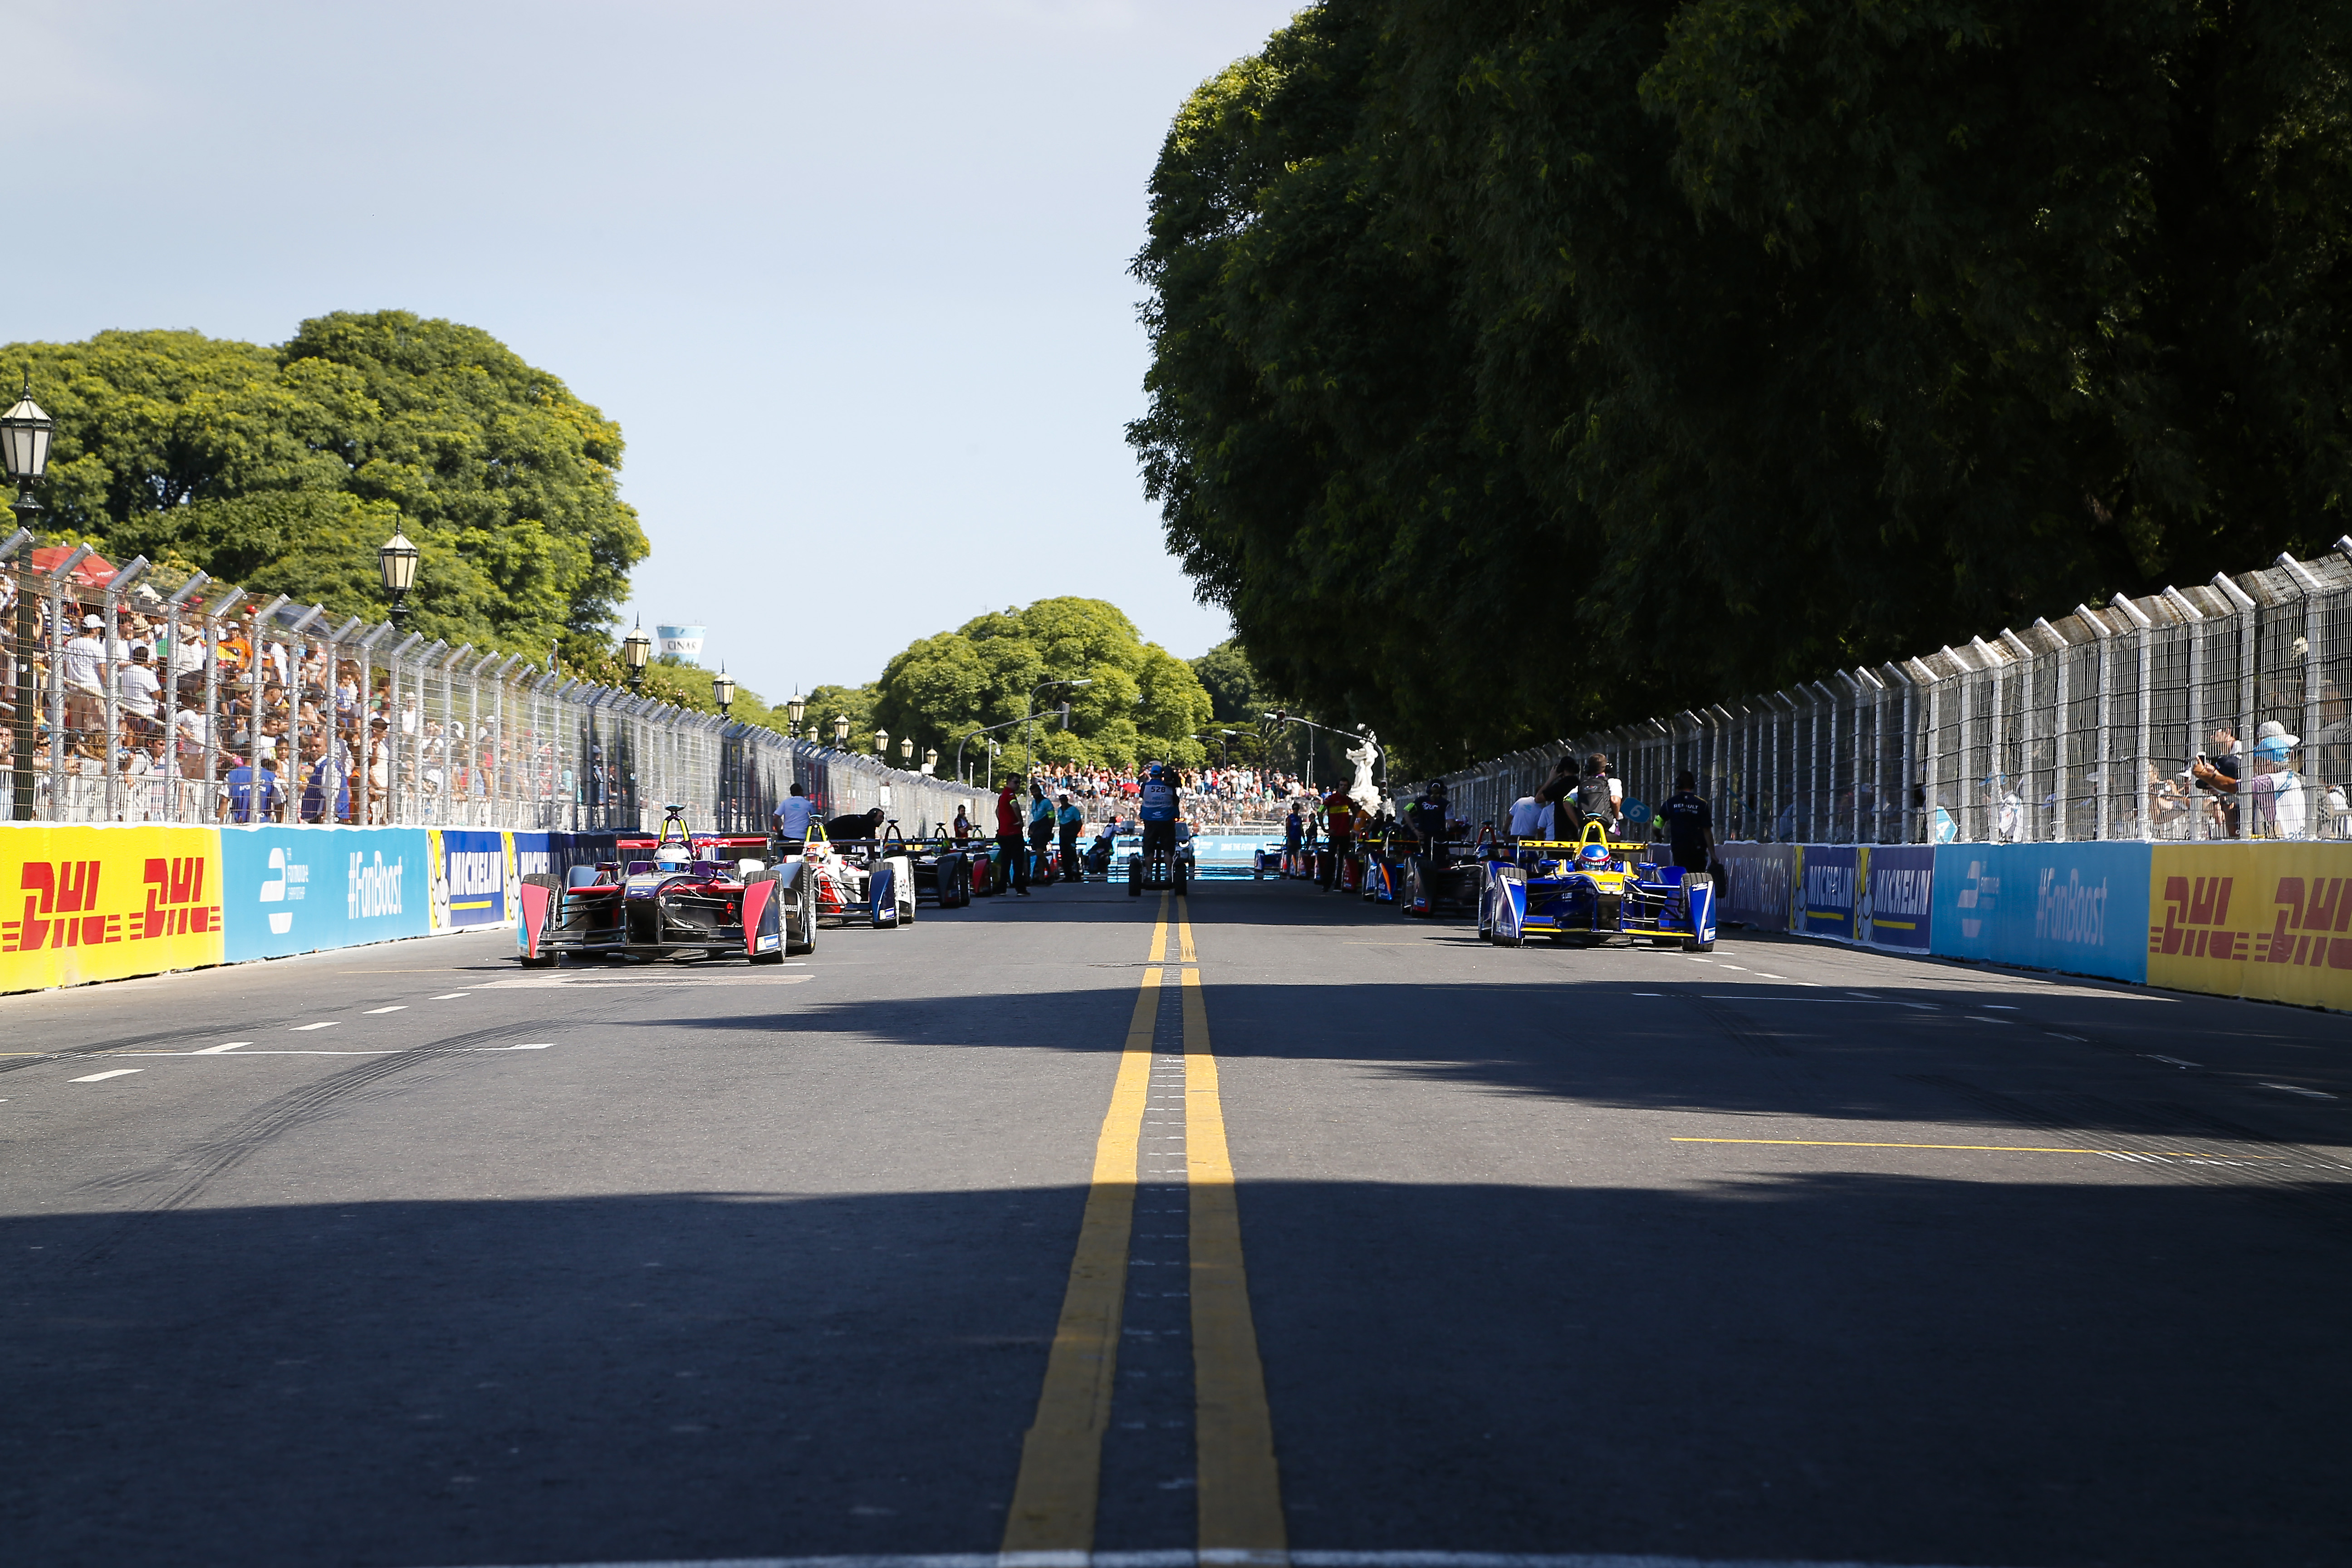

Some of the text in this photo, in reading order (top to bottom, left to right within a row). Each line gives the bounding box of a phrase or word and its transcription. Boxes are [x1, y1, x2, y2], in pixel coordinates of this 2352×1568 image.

[20, 861, 106, 951] DHL
[143, 857, 209, 939] DHL
[348, 850, 402, 920] #FanBoost
[450, 851, 501, 896] MICHELIN
[1808, 866, 1855, 908] MICHELIN
[1874, 869, 1931, 915] MICHELIN
[2036, 867, 2107, 946] #FanBoost
[2161, 877, 2236, 960] DHL
[2267, 877, 2352, 970] DHL
